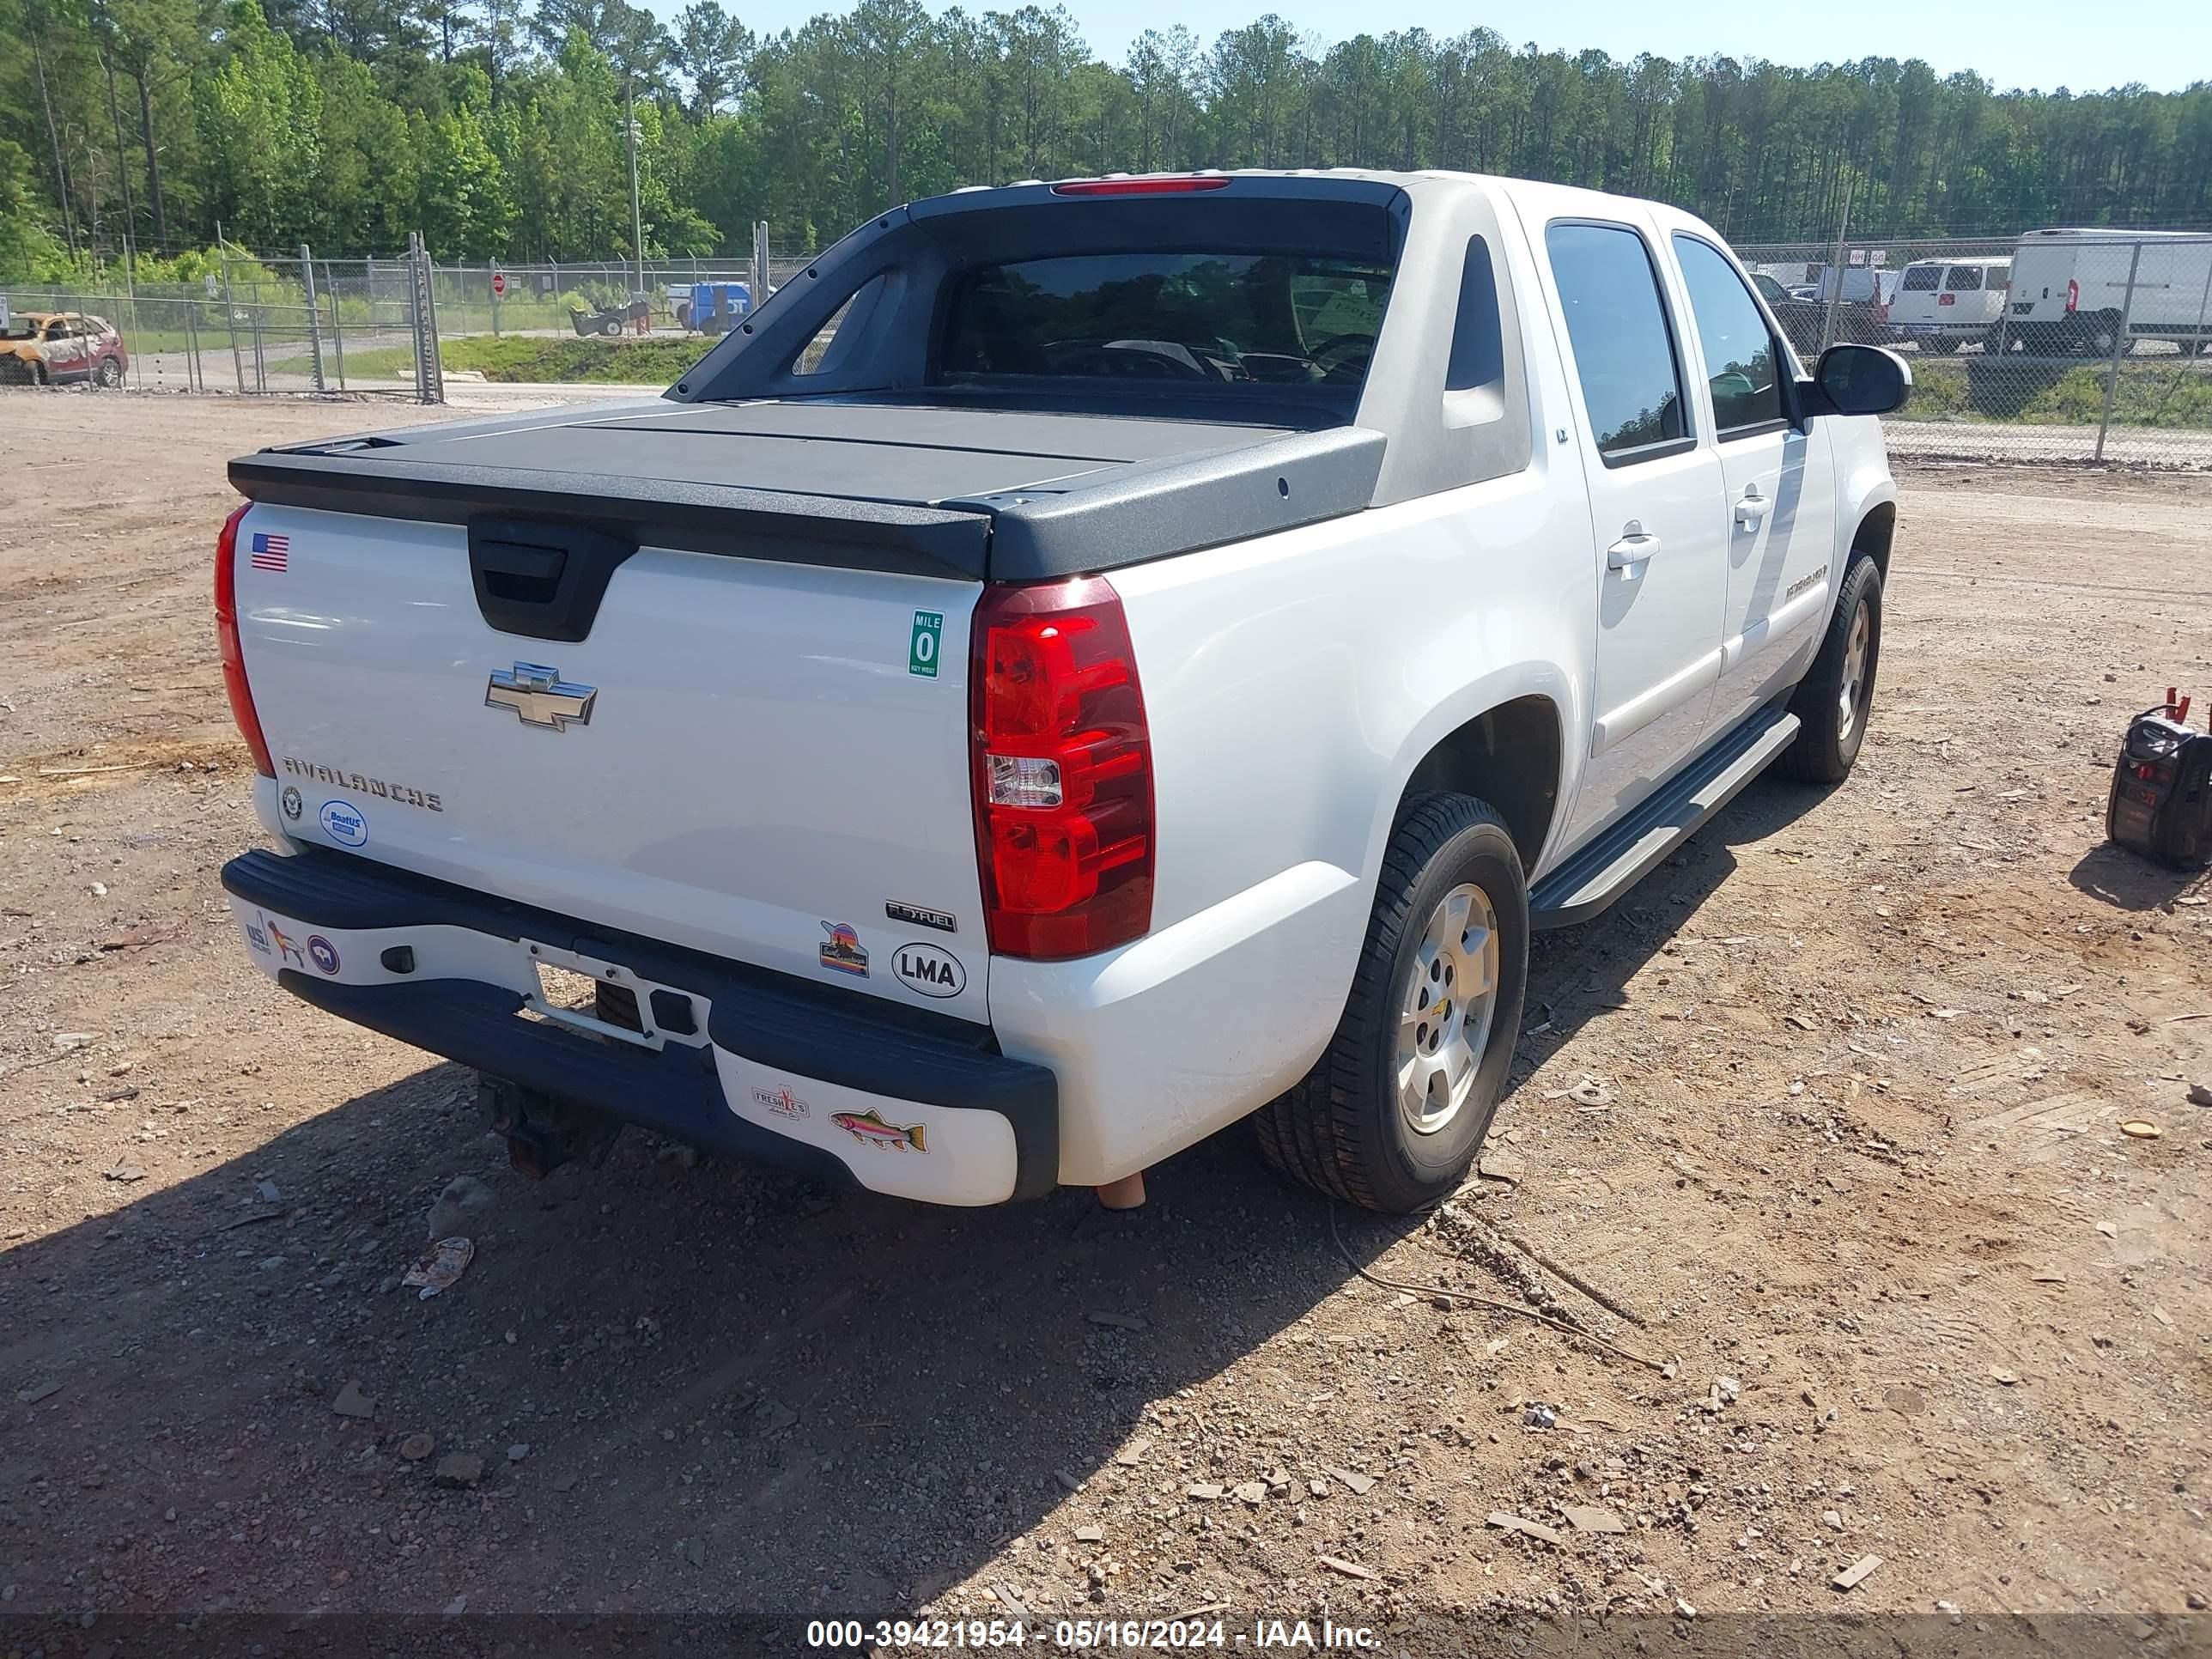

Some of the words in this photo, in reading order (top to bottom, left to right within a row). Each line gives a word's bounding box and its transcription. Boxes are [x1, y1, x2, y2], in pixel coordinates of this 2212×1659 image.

[915, 615, 941, 629] MILE
[916, 632, 934, 662] 0
[921, 665, 936, 674] WEST
[282, 756, 444, 812] AVALANCHE
[331, 811, 361, 828] BoatUS
[901, 952, 957, 988] LMA
